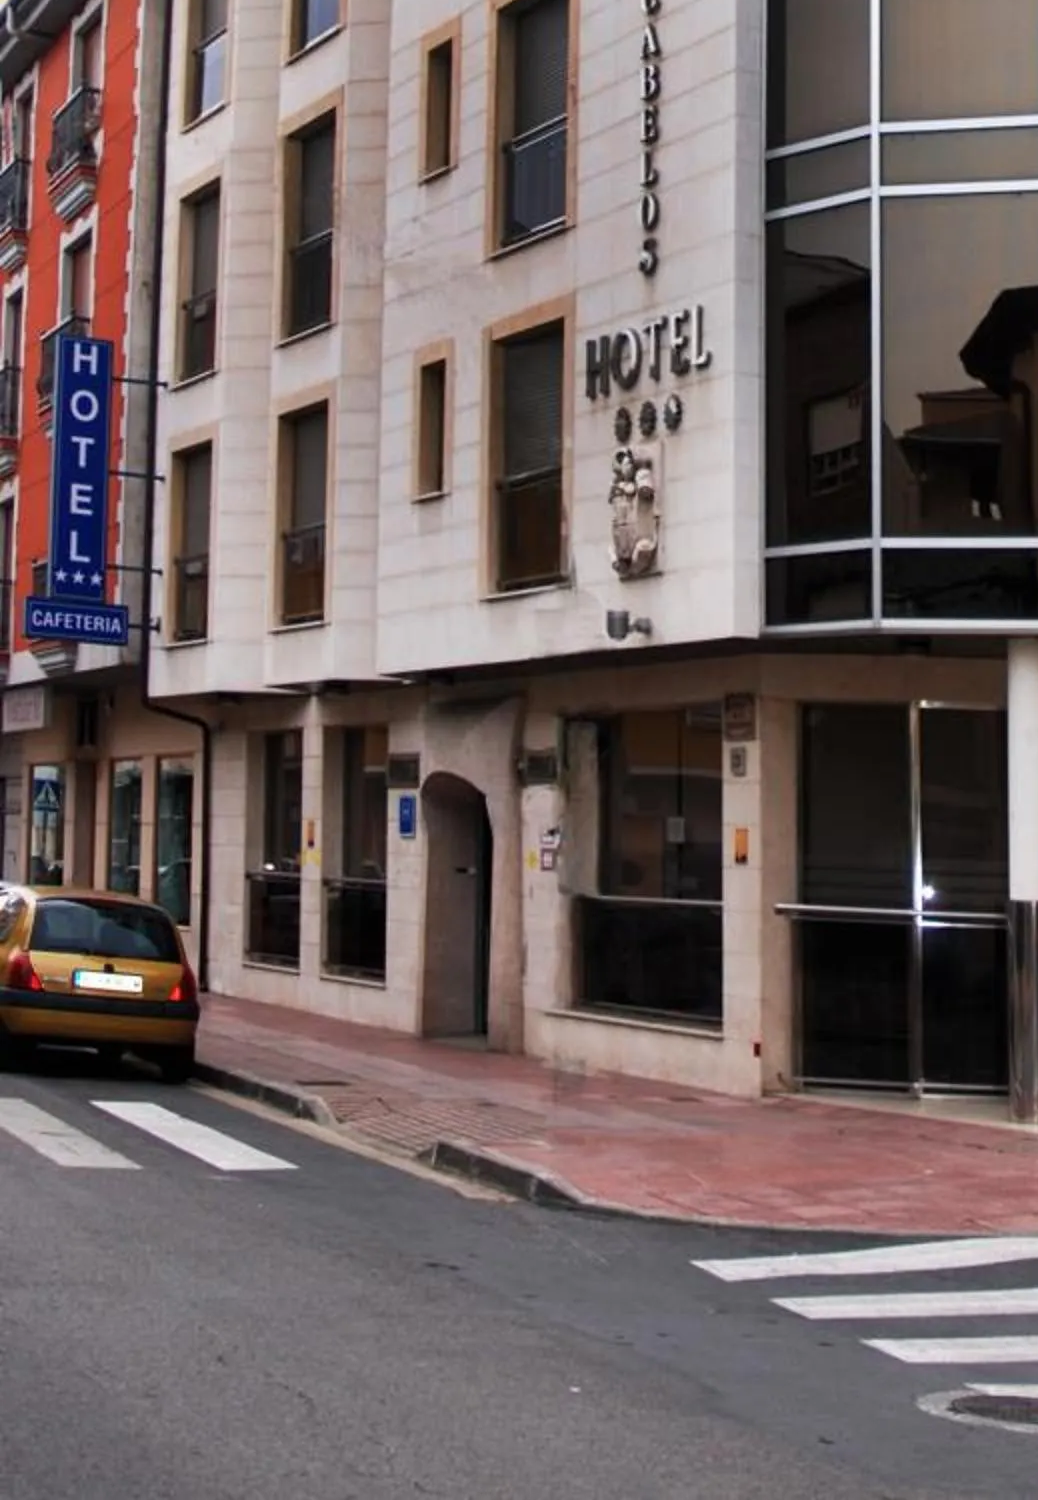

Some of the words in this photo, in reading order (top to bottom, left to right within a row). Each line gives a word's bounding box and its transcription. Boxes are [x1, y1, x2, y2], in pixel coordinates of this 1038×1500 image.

[585, 305, 712, 401] HOTEL
[69, 342, 99, 564] HOTEL
[31, 608, 122, 635] CAFETERIA
